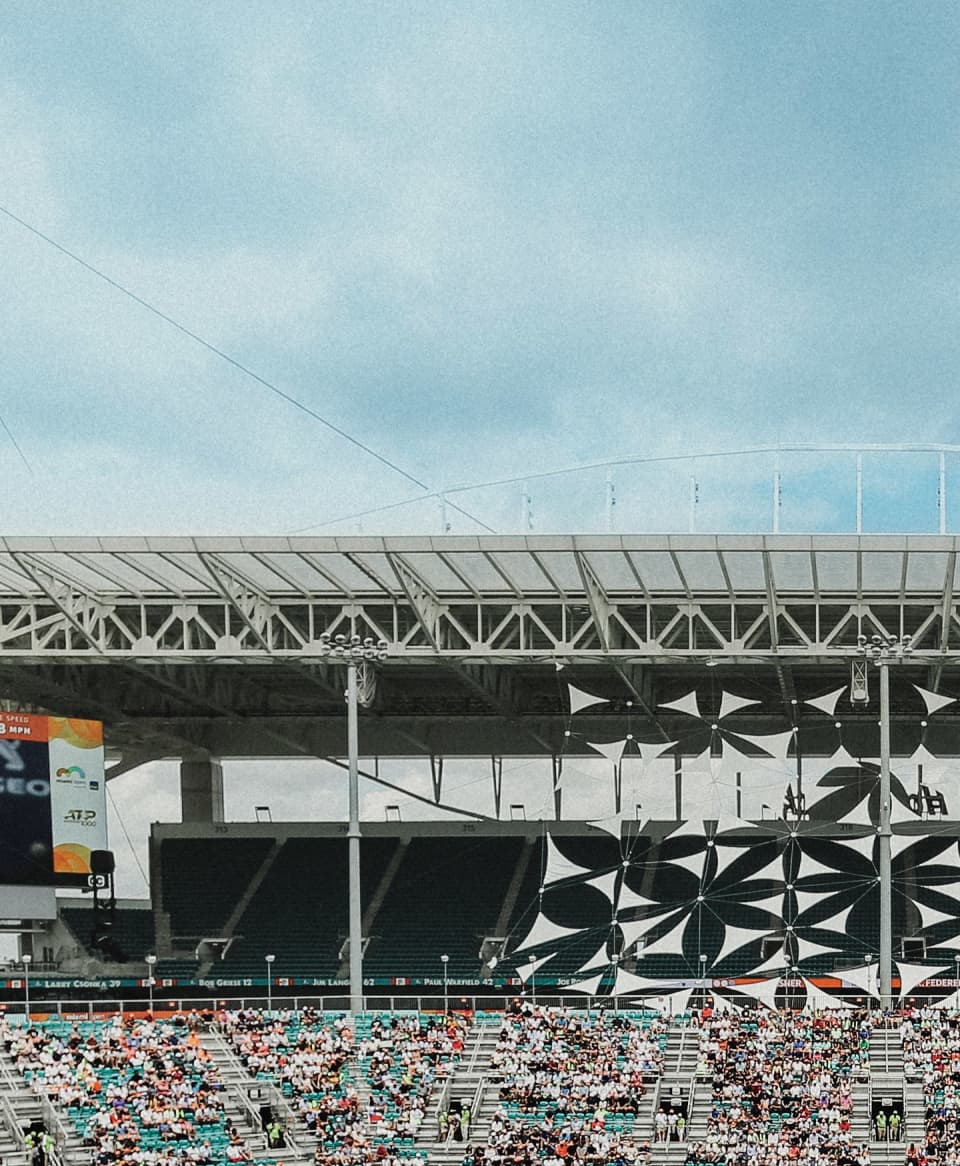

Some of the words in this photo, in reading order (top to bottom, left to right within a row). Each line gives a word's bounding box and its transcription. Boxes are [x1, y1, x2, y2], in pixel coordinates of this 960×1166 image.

[6, 714, 30, 723] SPEED
[9, 726, 31, 735] MPH
[64, 809, 97, 820] ATP
